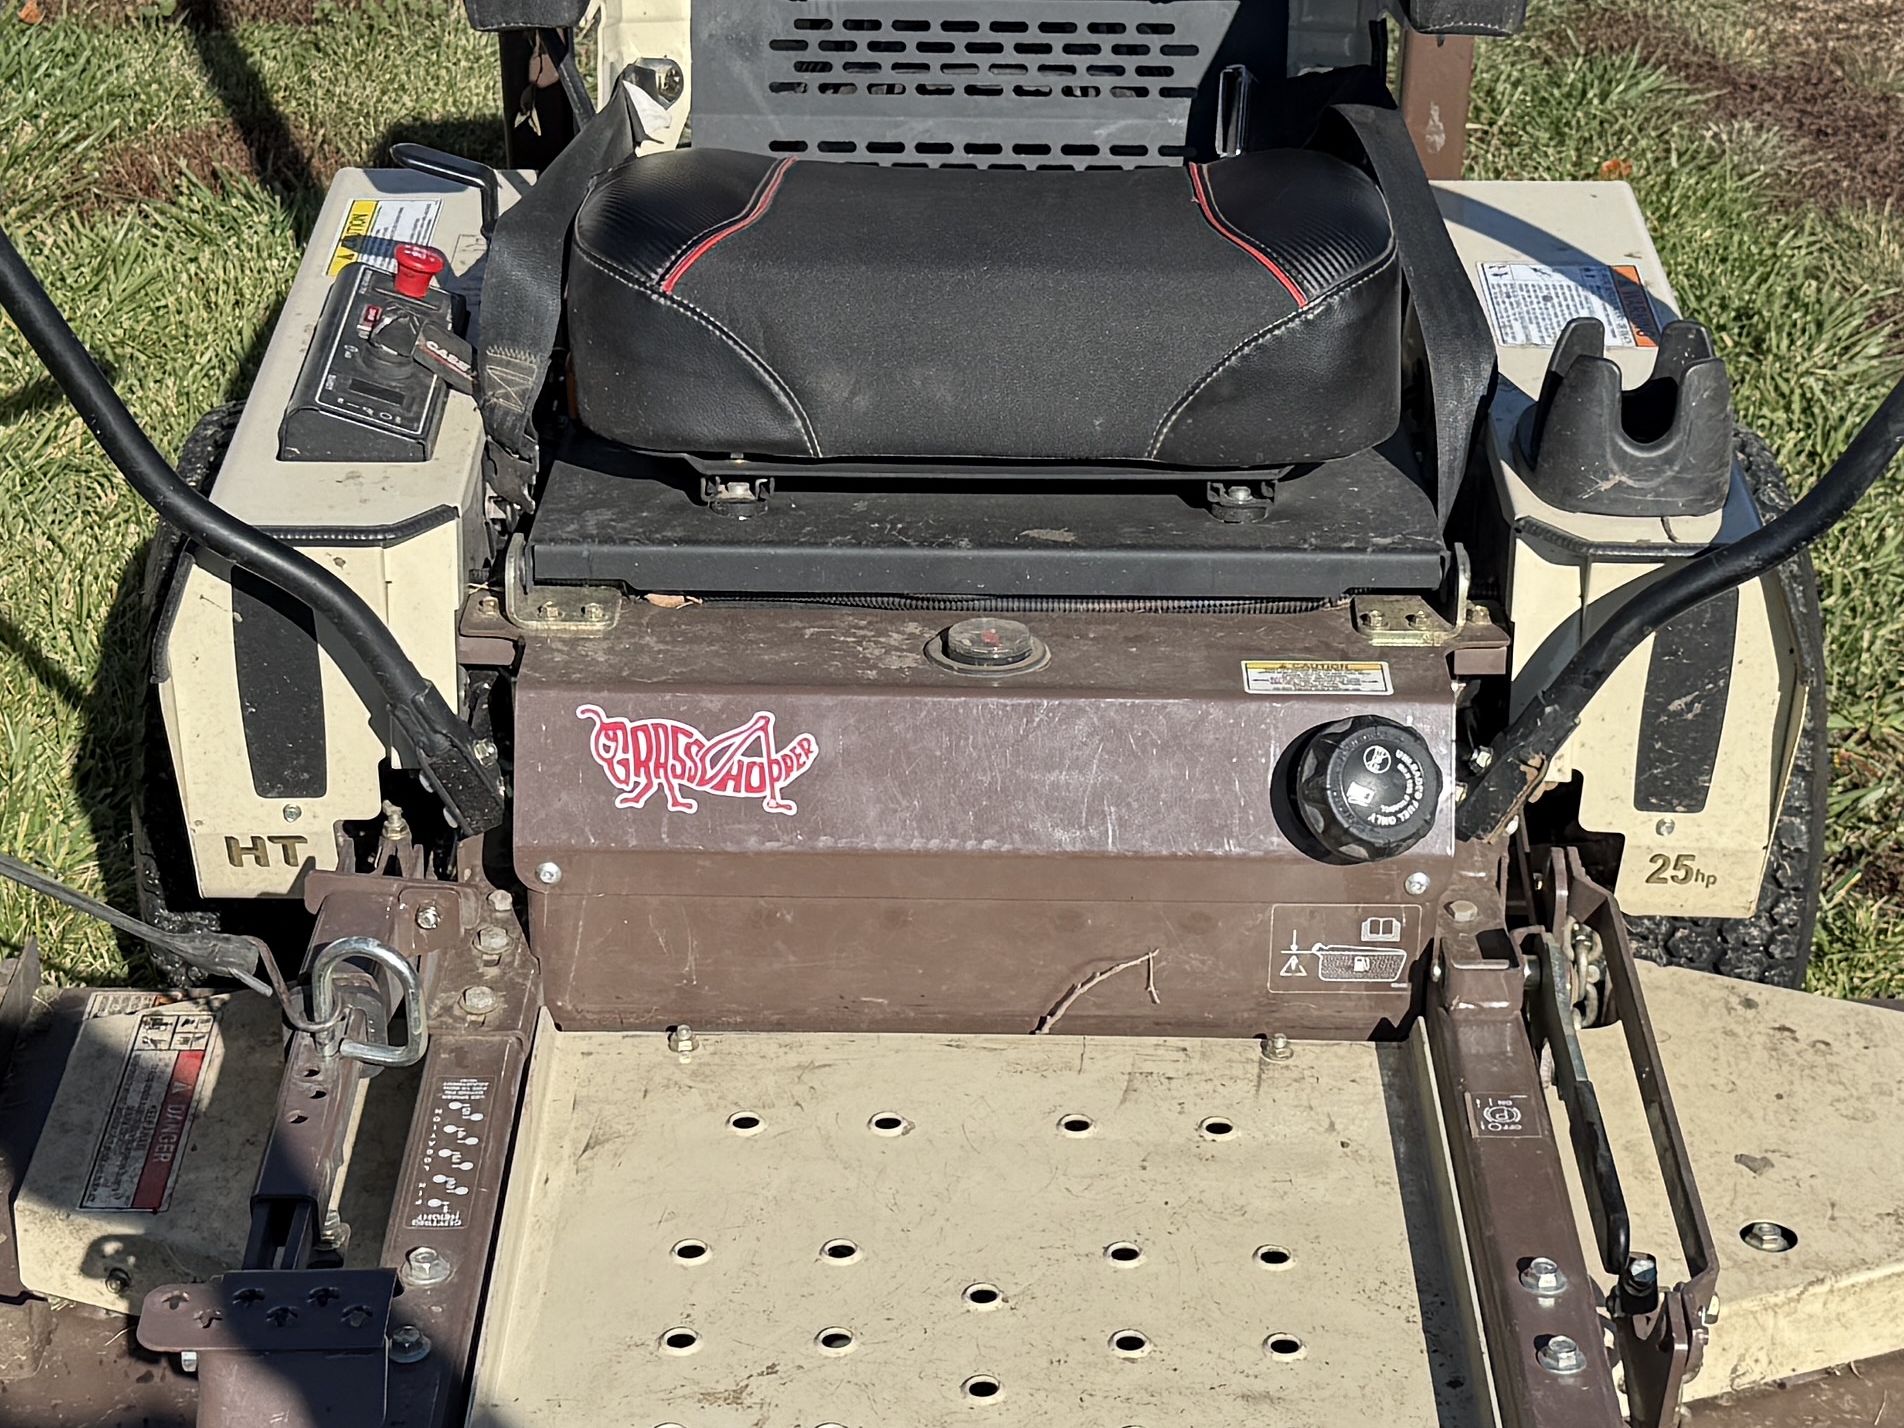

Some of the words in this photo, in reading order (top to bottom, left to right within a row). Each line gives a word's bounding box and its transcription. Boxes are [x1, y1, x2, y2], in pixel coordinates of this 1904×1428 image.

[593, 716, 815, 801] GRASSHOPPER
[1367, 812, 1397, 826] ONLY
[1397, 799, 1420, 822] FUEL
[225, 835, 308, 868] HT
[1644, 853, 1718, 889] 25hp
[152, 1104, 185, 1163] DANGER
